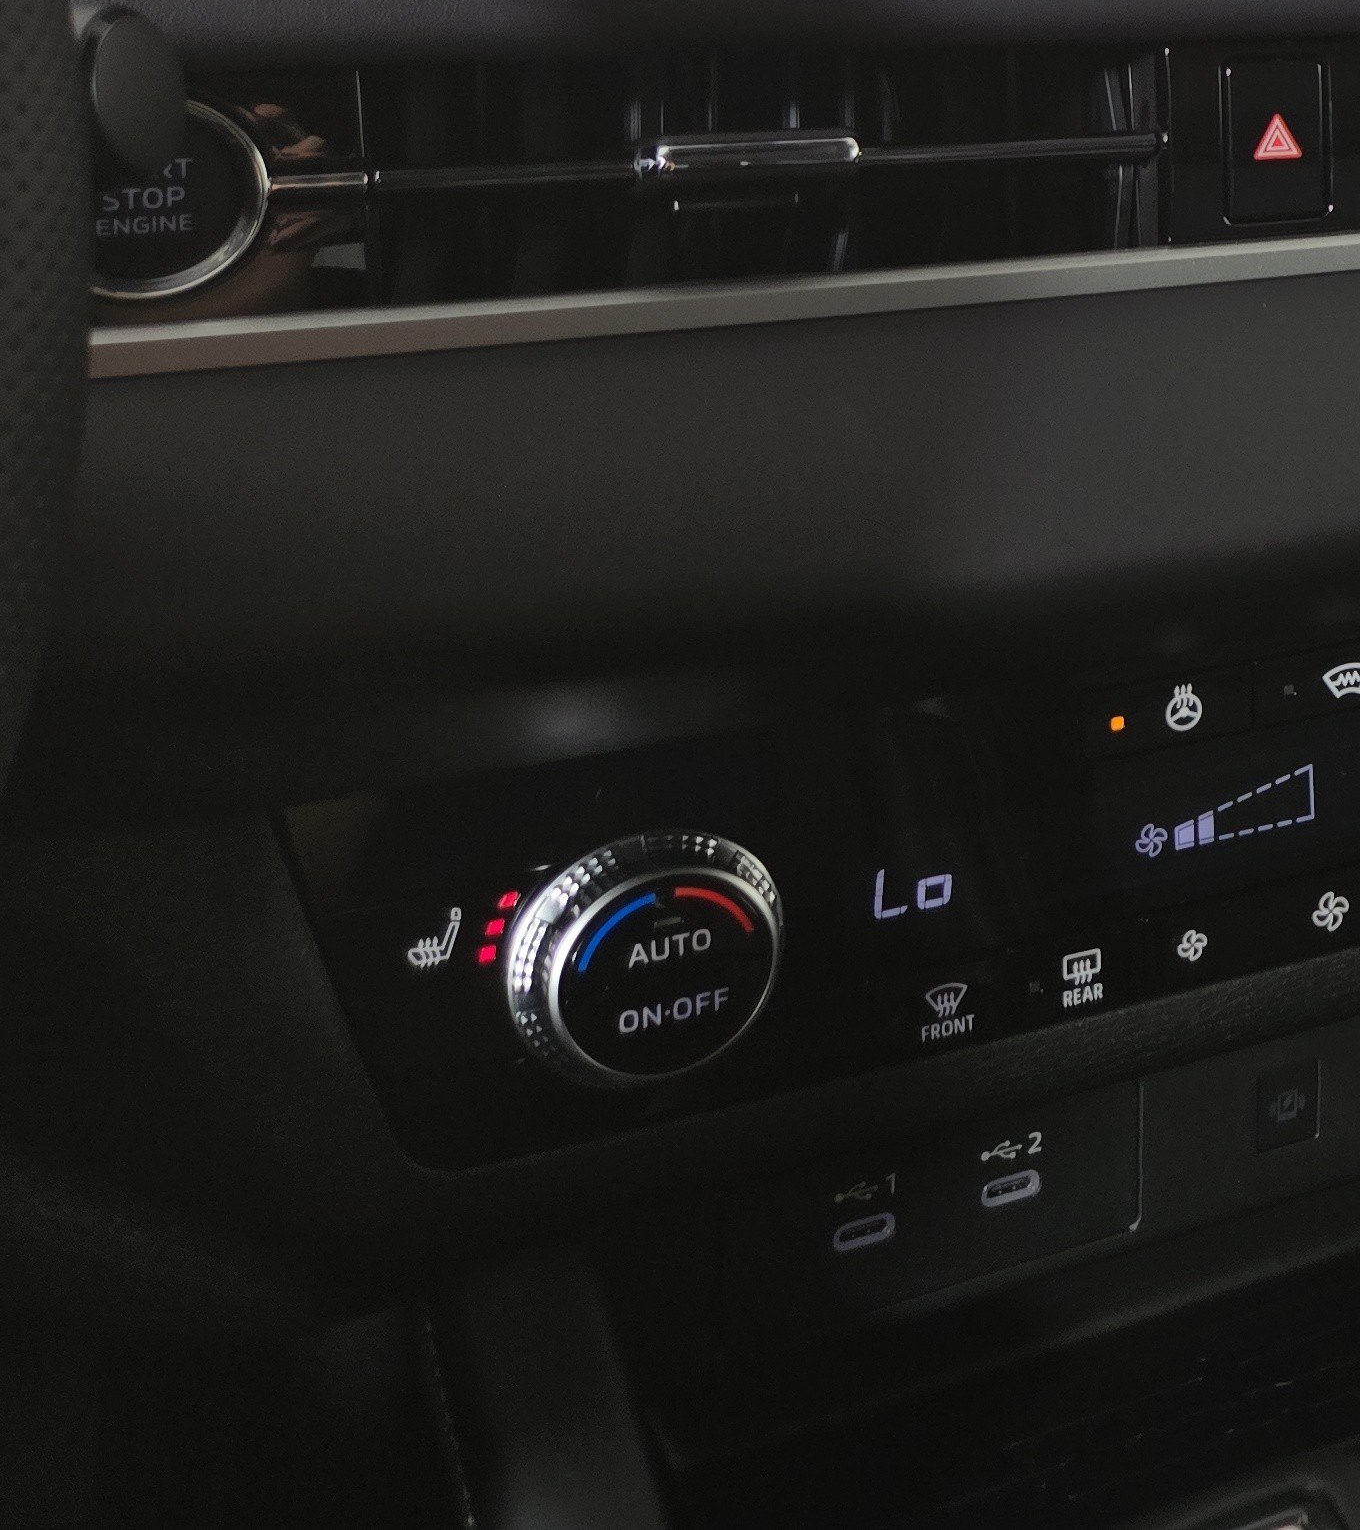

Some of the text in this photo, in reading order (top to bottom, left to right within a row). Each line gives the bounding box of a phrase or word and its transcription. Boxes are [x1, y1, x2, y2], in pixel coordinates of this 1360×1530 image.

[101, 185, 186, 212] STOP
[94, 213, 193, 238] ENGINE
[873, 868, 954, 921] Lo
[628, 928, 712, 970] AUTO
[1061, 981, 1104, 1009] REAR
[920, 1013, 976, 1044] FRONT
[1027, 1131, 1043, 1156] 2
[884, 1172, 897, 1197] 1
